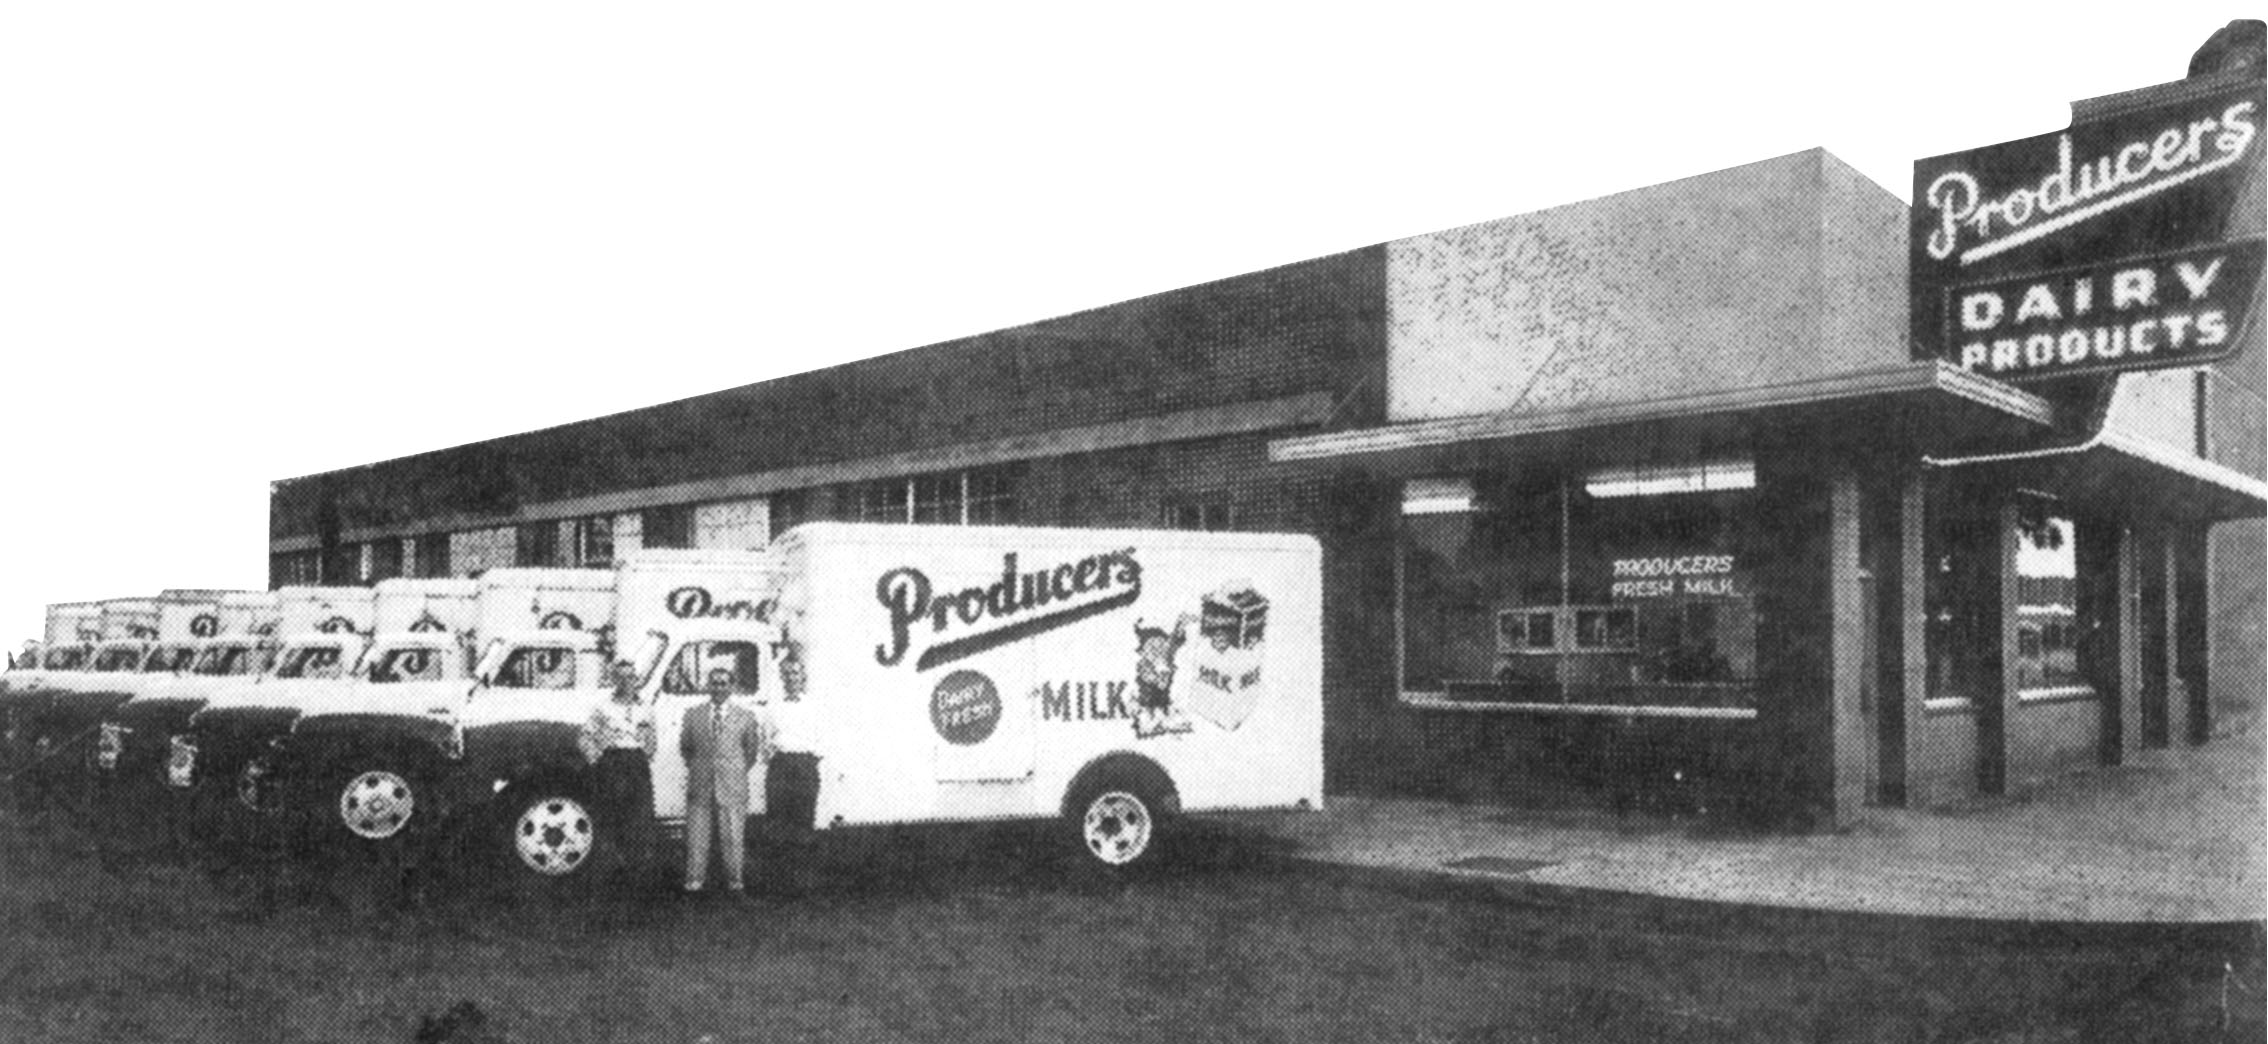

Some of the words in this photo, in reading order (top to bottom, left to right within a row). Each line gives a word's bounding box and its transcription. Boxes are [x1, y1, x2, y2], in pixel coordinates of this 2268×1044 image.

[1926, 101, 2256, 261] Producers
[1960, 256, 2226, 331] DAIRY
[1960, 310, 2228, 371] PRODUCTS
[1612, 555, 1734, 577] PRODUCERS
[874, 546, 1142, 667] Producers
[1612, 580, 1673, 597] FRESH
[1684, 579, 1734, 595] MILK
[937, 682, 985, 710] DAIRY
[939, 701, 992, 730] FRESH
[1041, 680, 1130, 722] MILK
